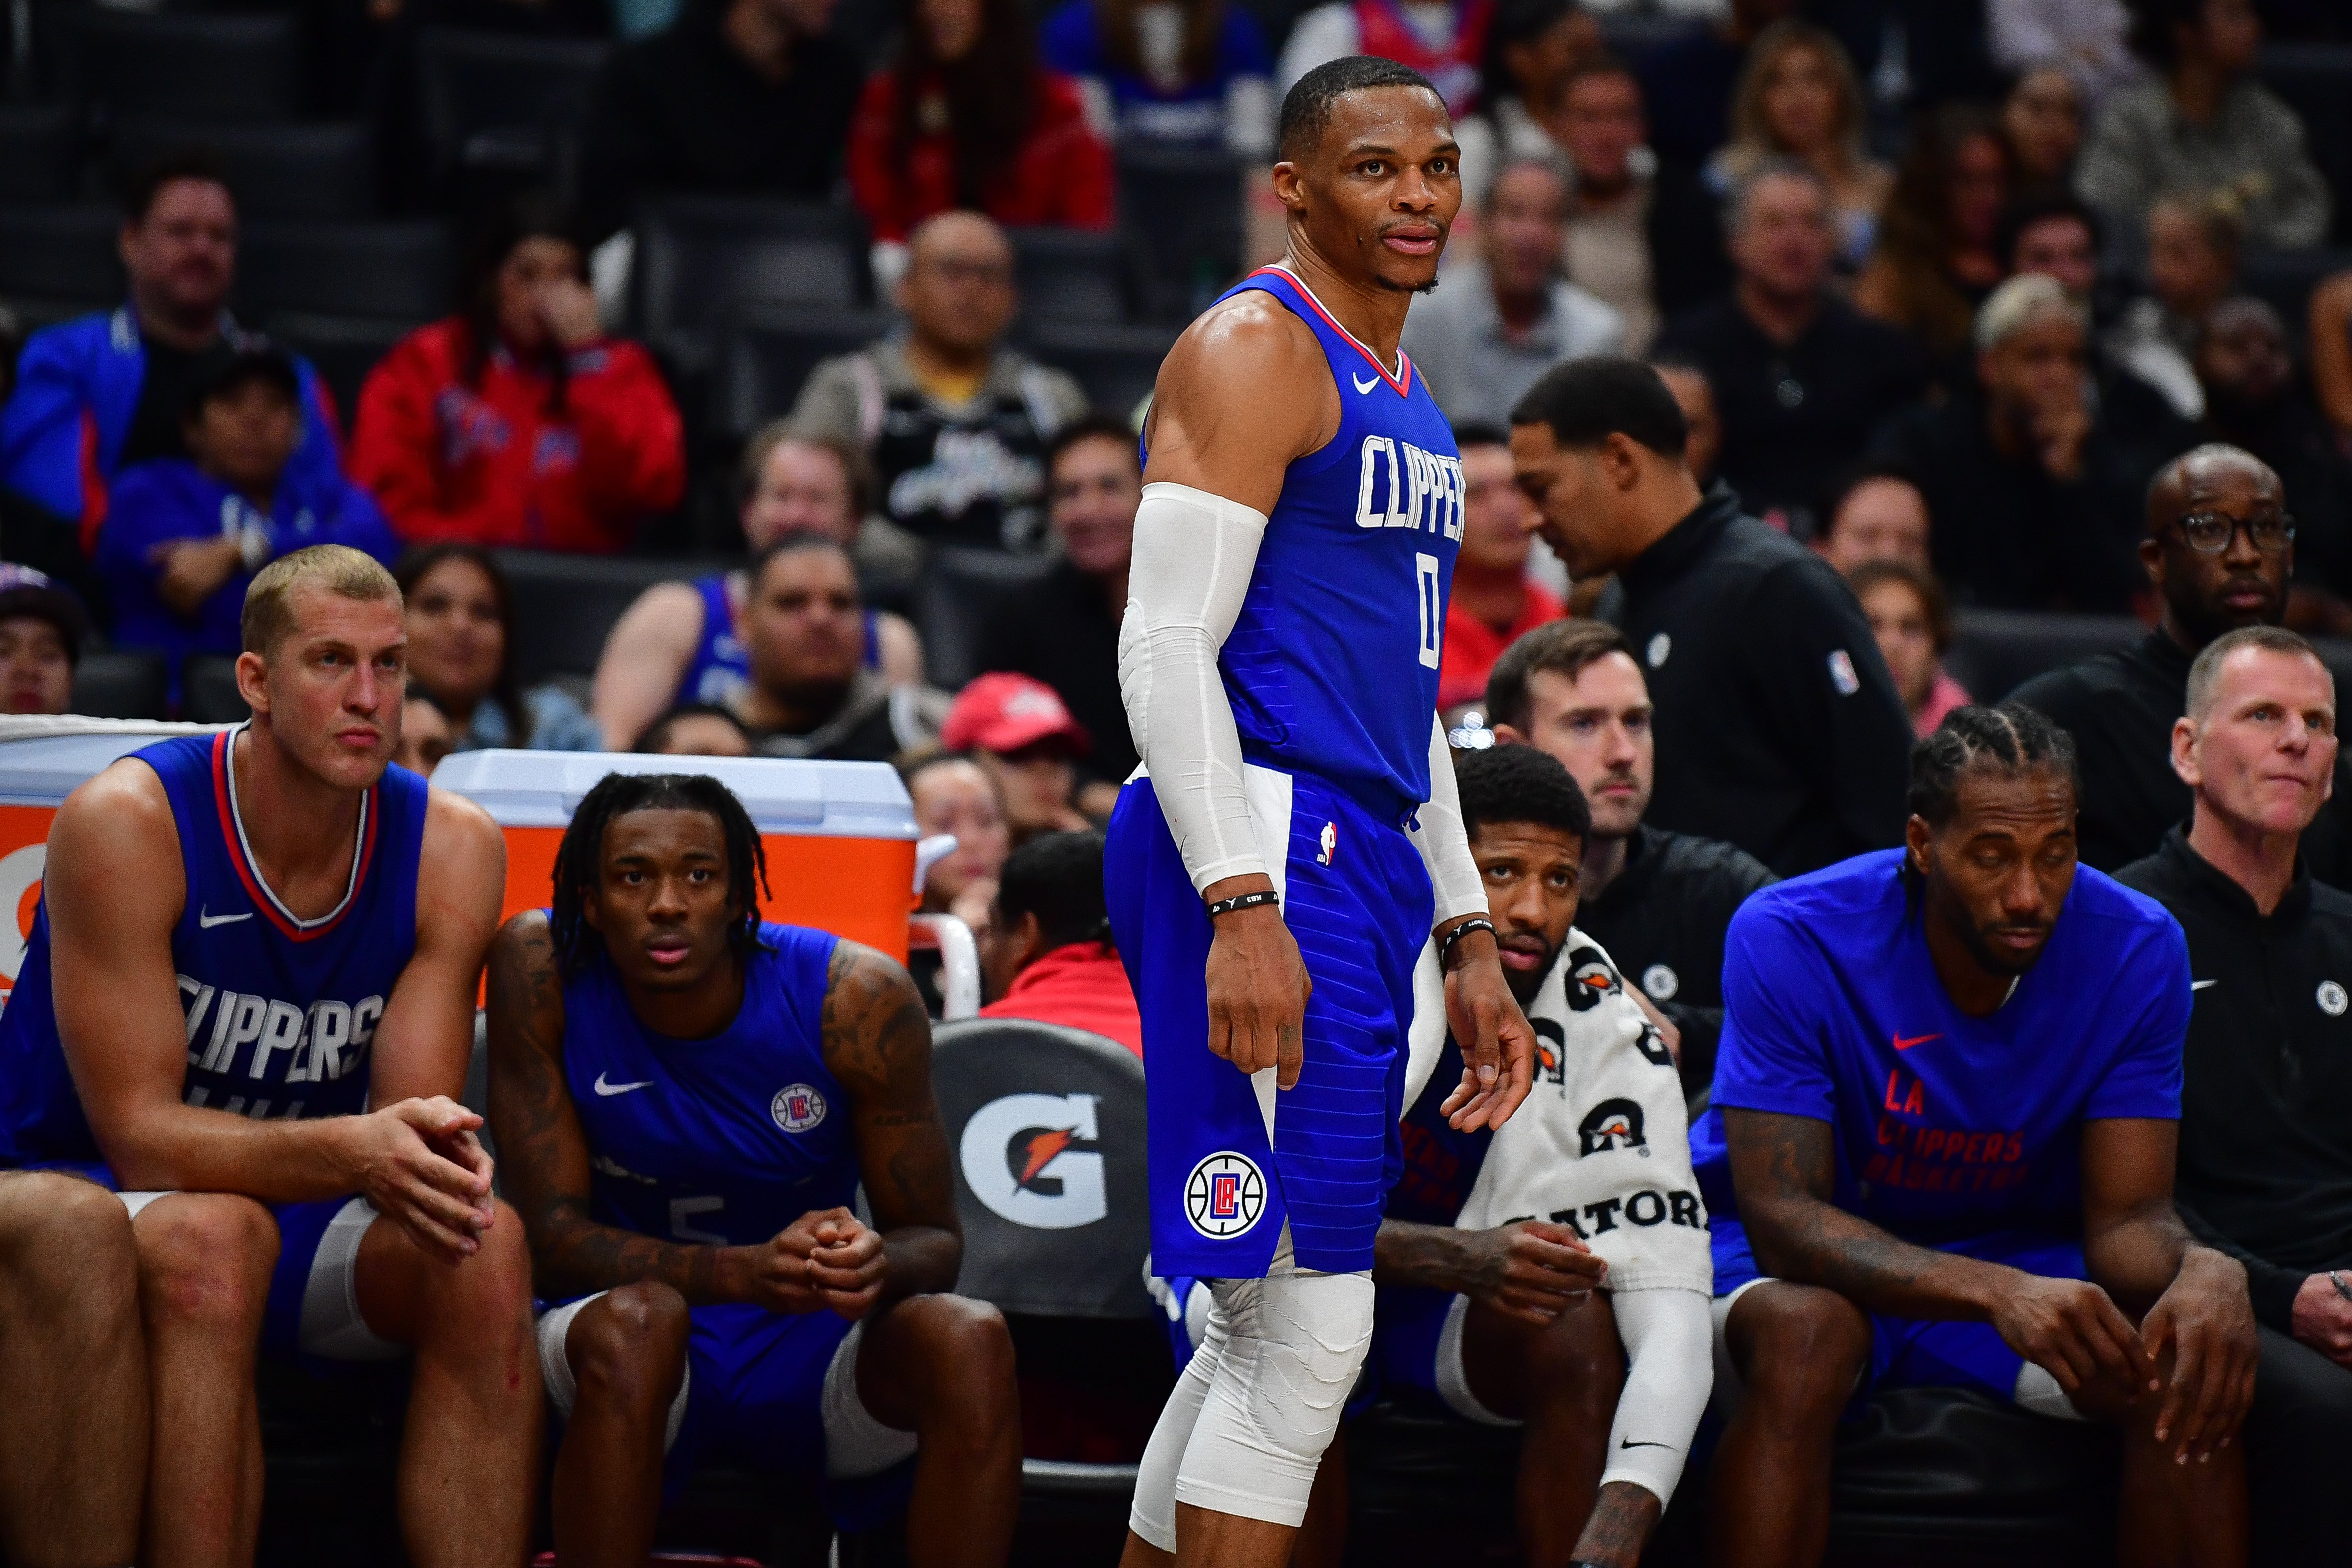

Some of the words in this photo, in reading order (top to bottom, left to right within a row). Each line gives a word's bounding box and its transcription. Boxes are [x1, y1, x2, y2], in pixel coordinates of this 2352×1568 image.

[1355, 435, 1466, 548] CLIPPER
[1416, 552, 1440, 670] 0
[1885, 1068, 1924, 1116] LA
[959, 1092, 1107, 1229] G
